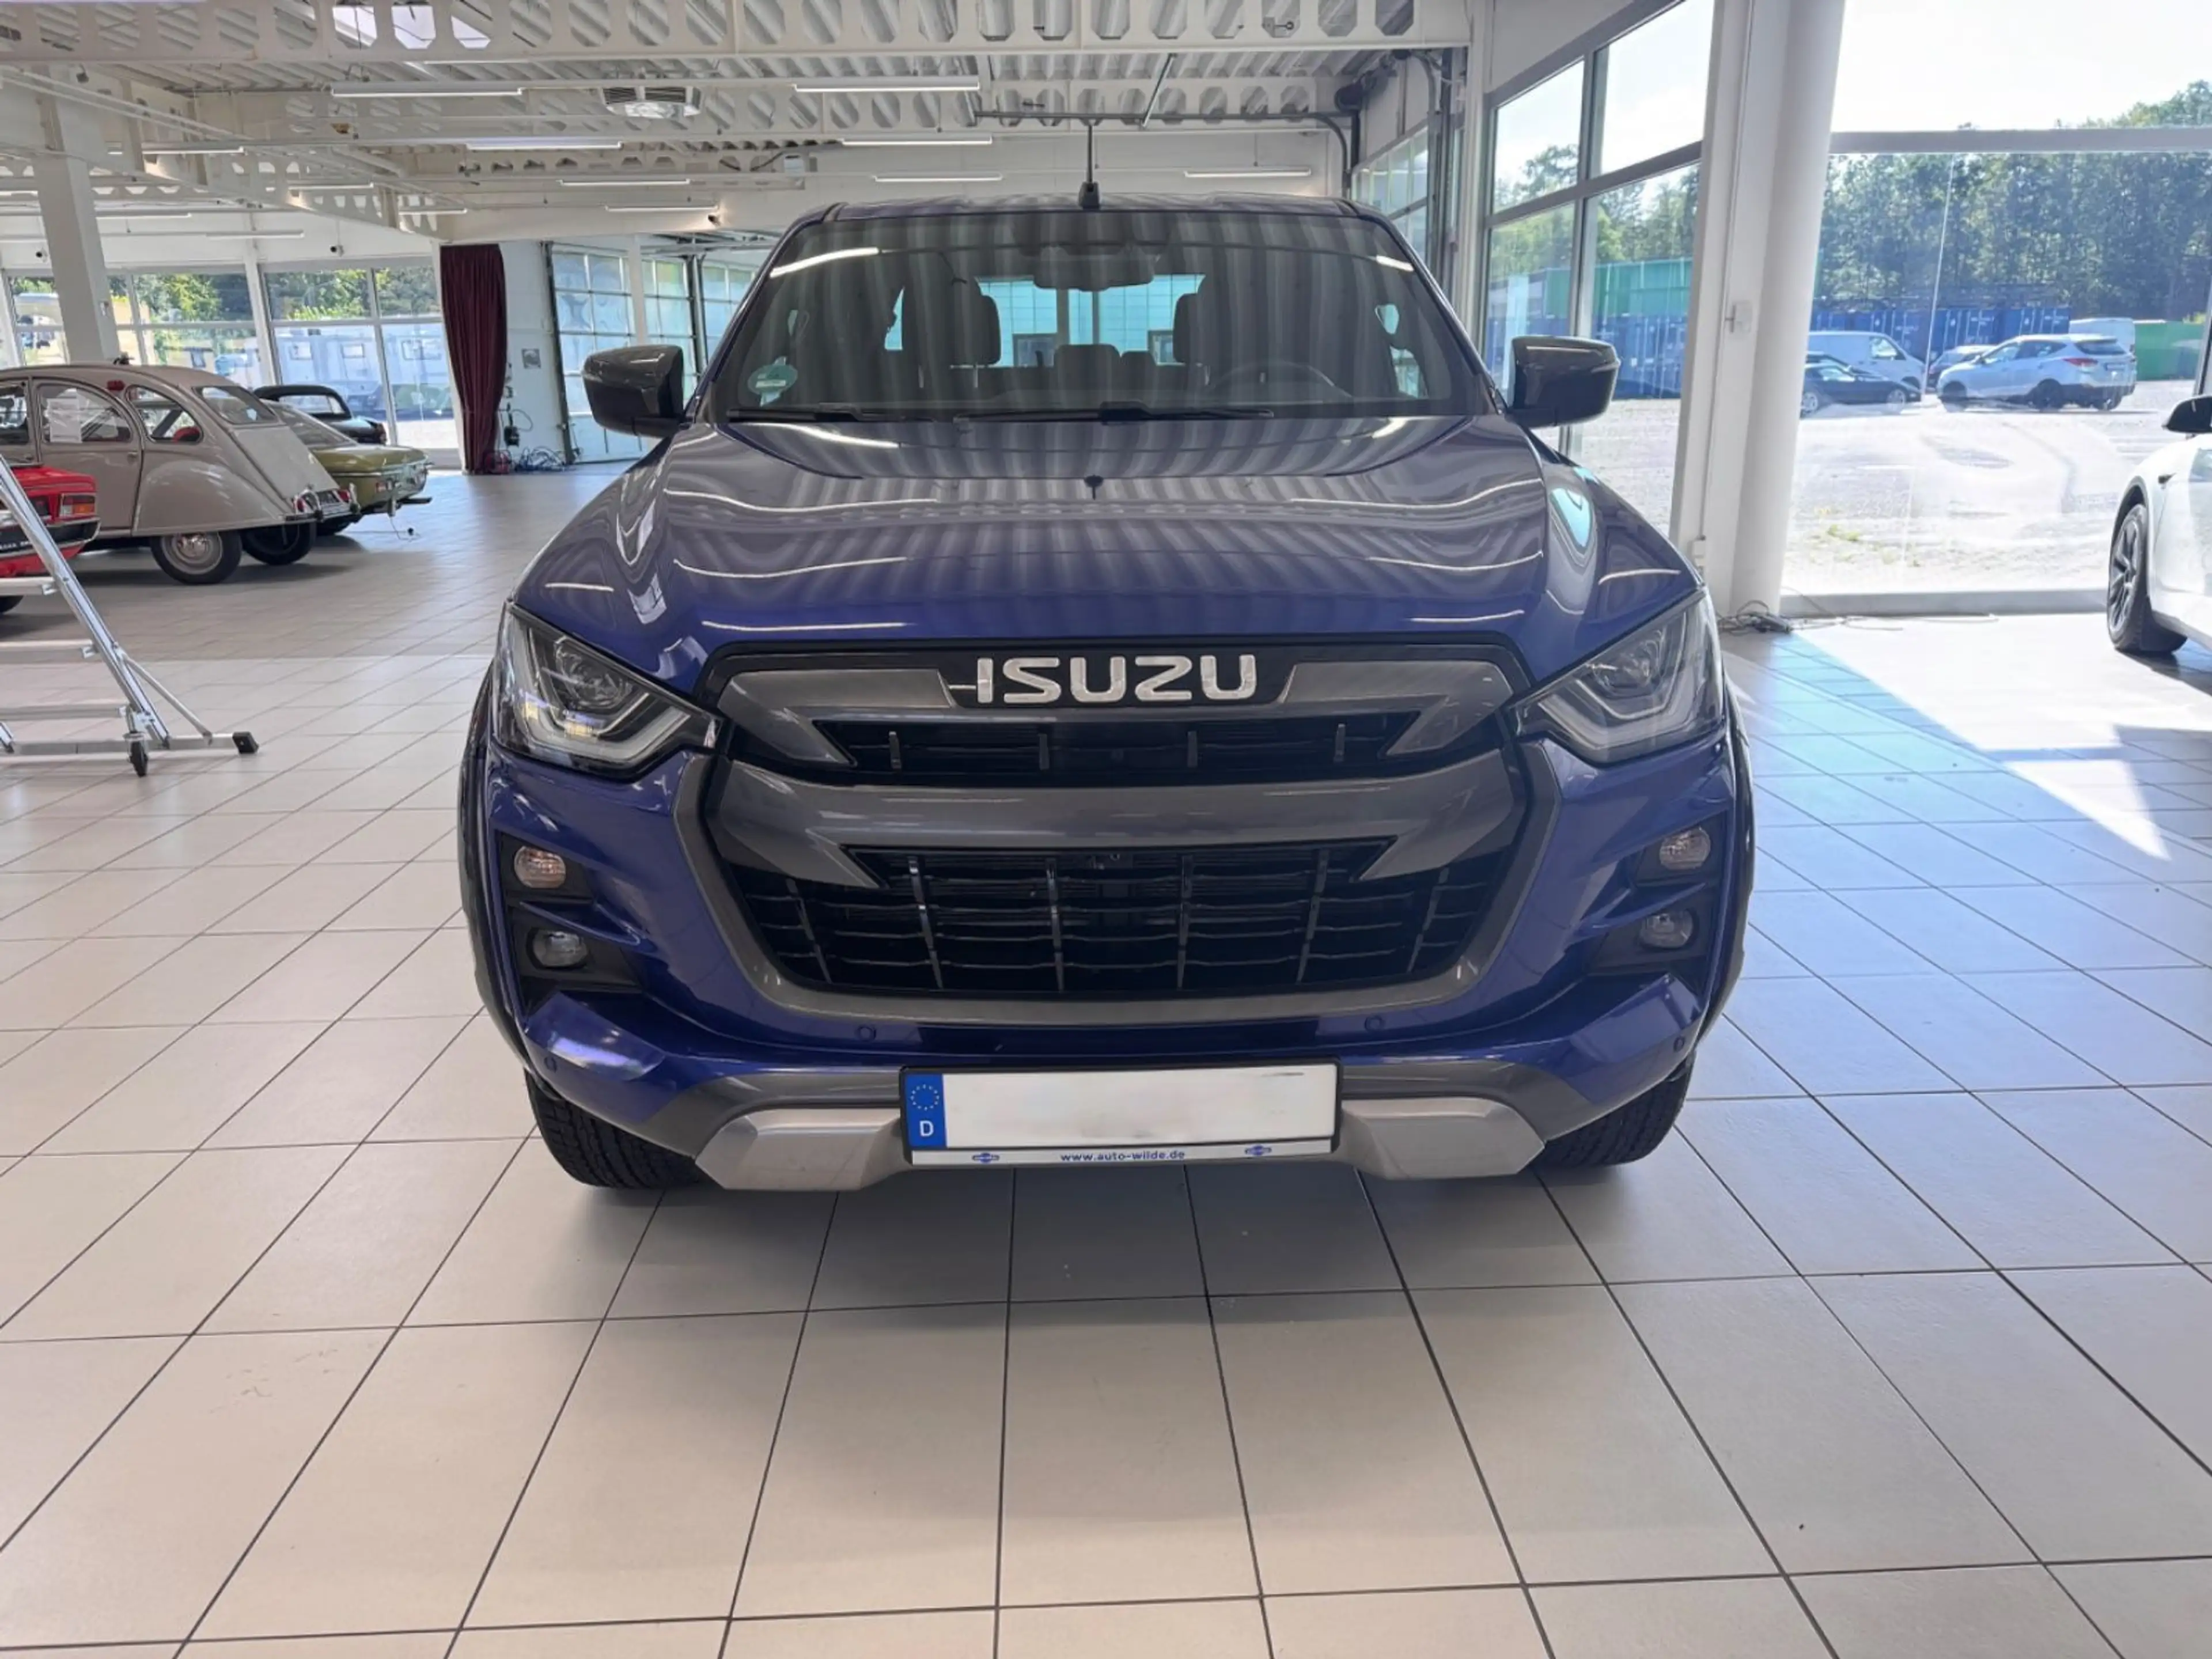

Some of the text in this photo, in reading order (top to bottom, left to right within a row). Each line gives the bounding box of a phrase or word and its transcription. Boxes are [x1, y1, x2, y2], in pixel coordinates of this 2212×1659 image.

[977, 654, 1256, 703] ISUZU
[919, 1120, 934, 1137] D
[1060, 1150, 1185, 1161] www.auto-wilde.de
